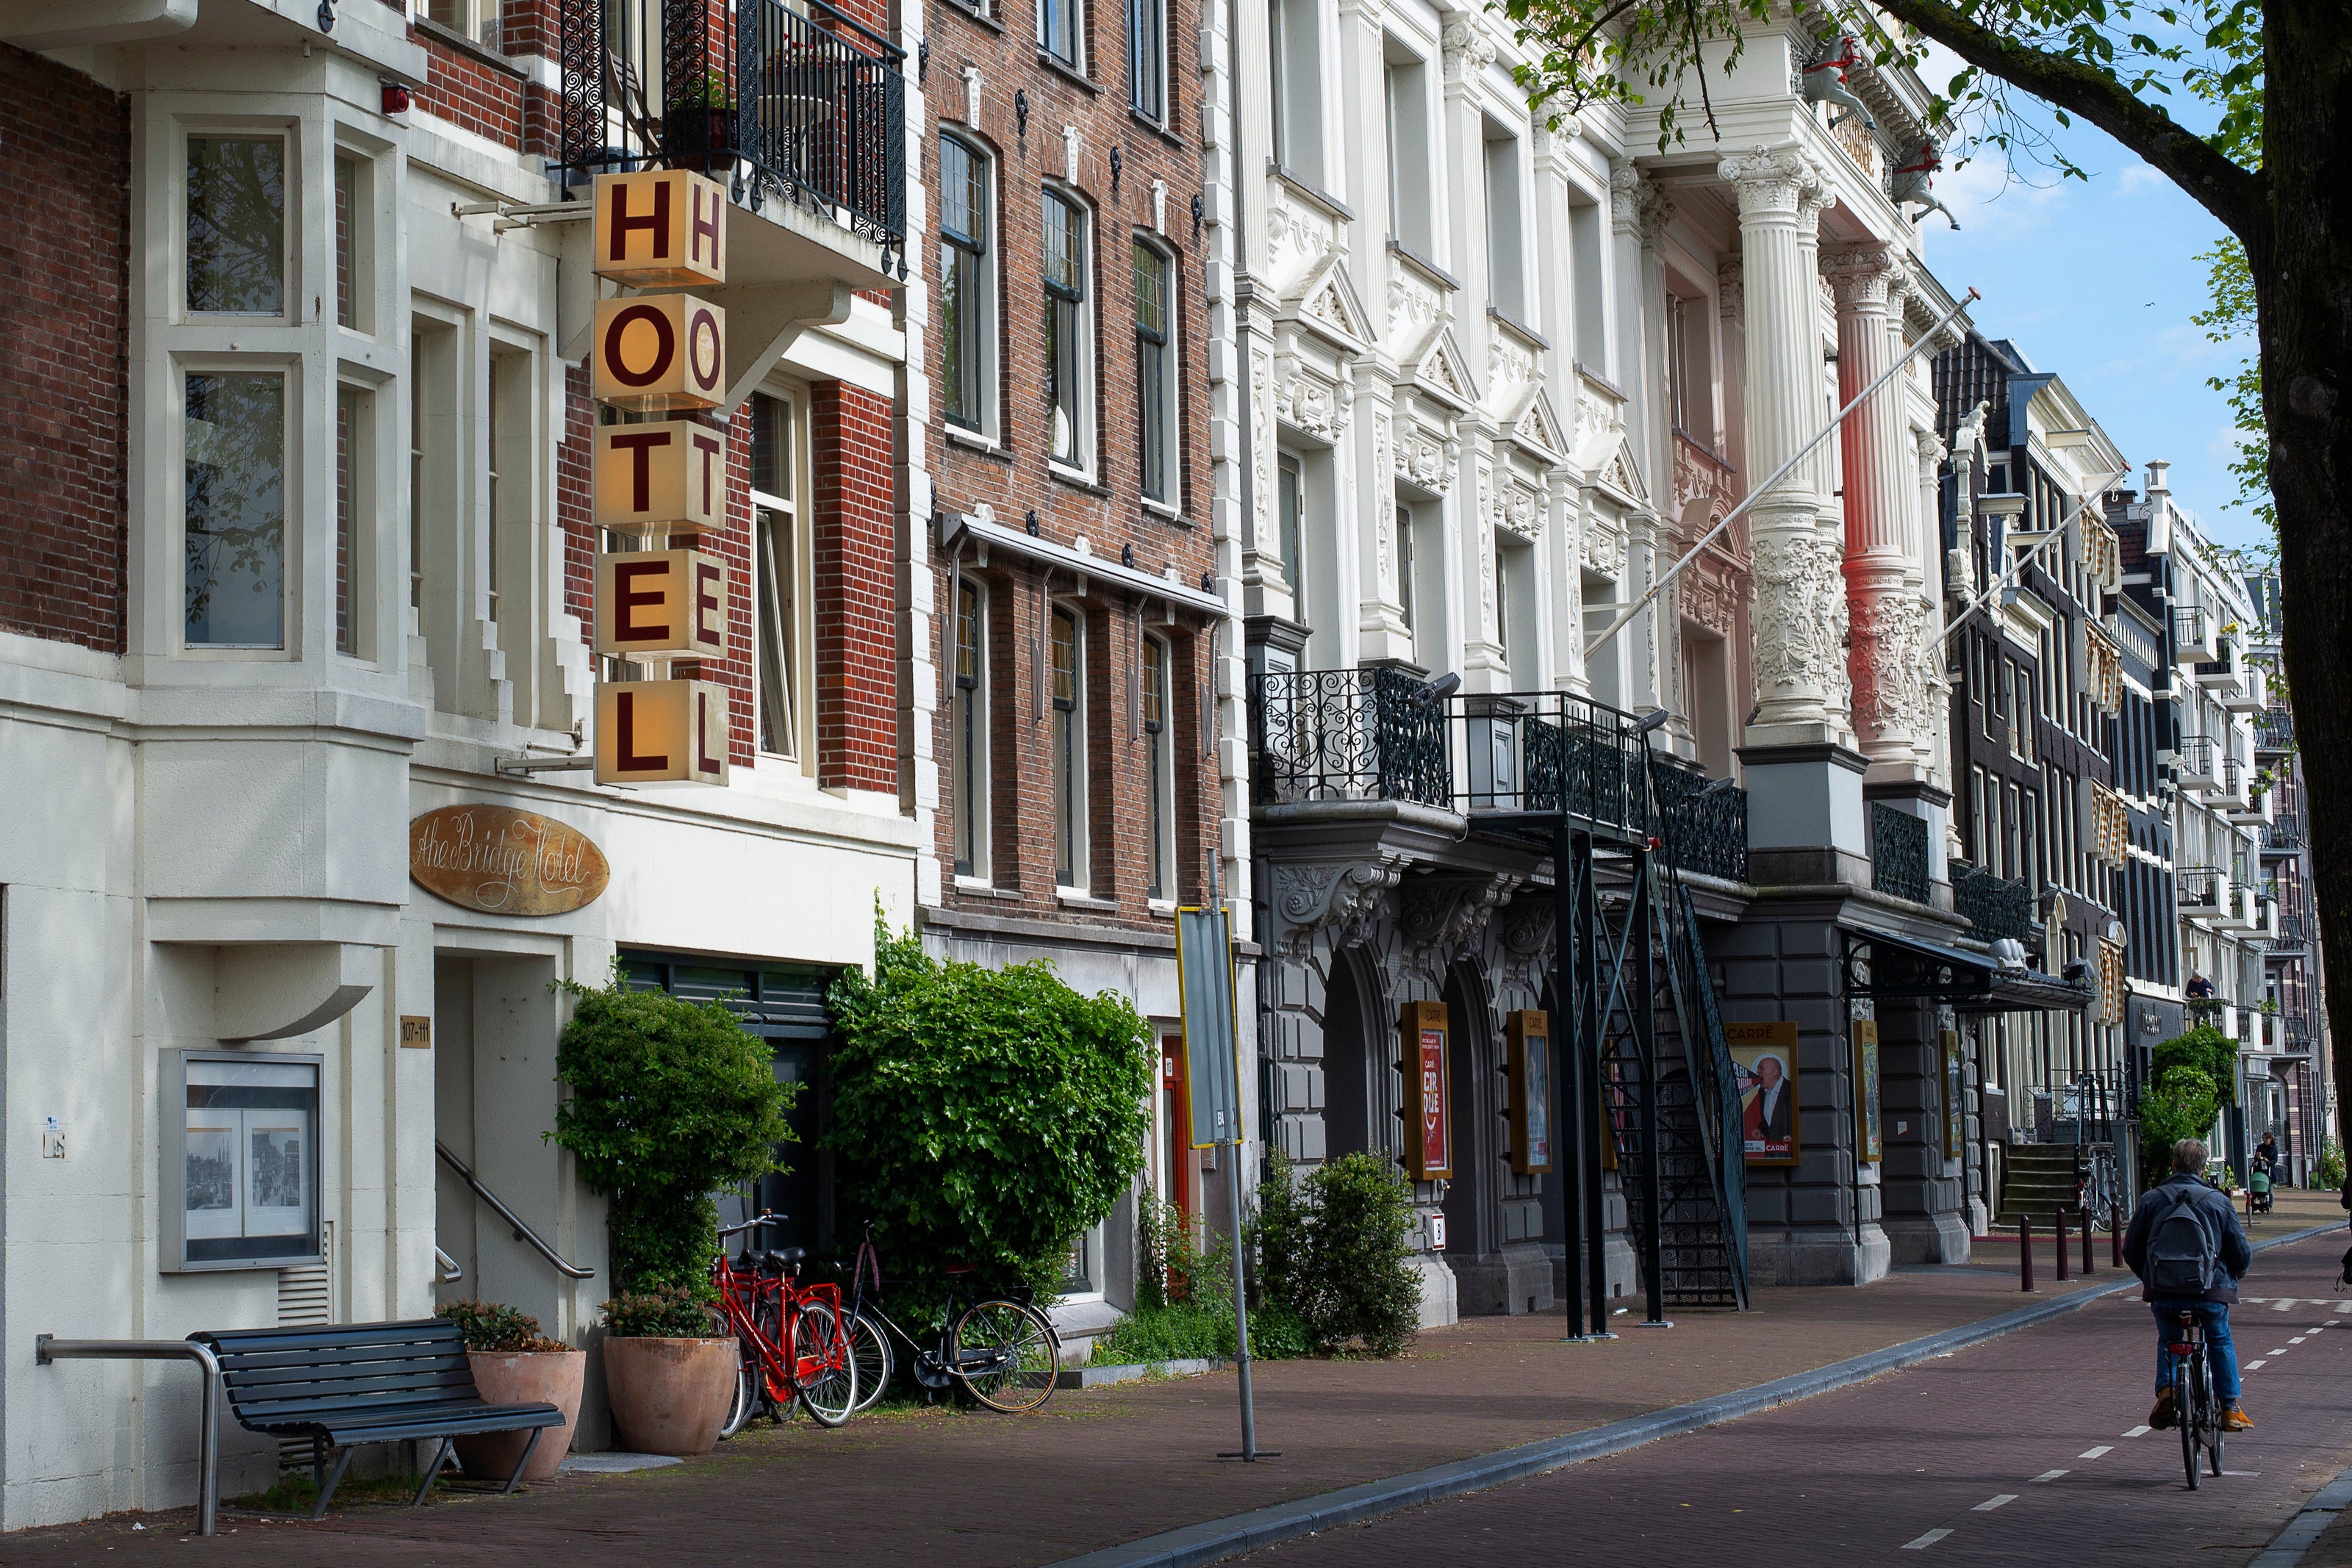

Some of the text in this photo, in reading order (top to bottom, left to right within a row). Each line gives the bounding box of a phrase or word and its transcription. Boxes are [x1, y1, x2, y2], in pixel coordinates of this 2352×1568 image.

[605, 183, 675, 772] HOTEL
[689, 184, 720, 774] HOTEL
[450, 810, 528, 907] Bridge
[512, 819, 590, 902] Hotel
[402, 1021, 429, 1042] 107-111
[1424, 1071, 1438, 1092] CIR
[1423, 1093, 1439, 1126] QUE
[1437, 1223, 1441, 1240] B
